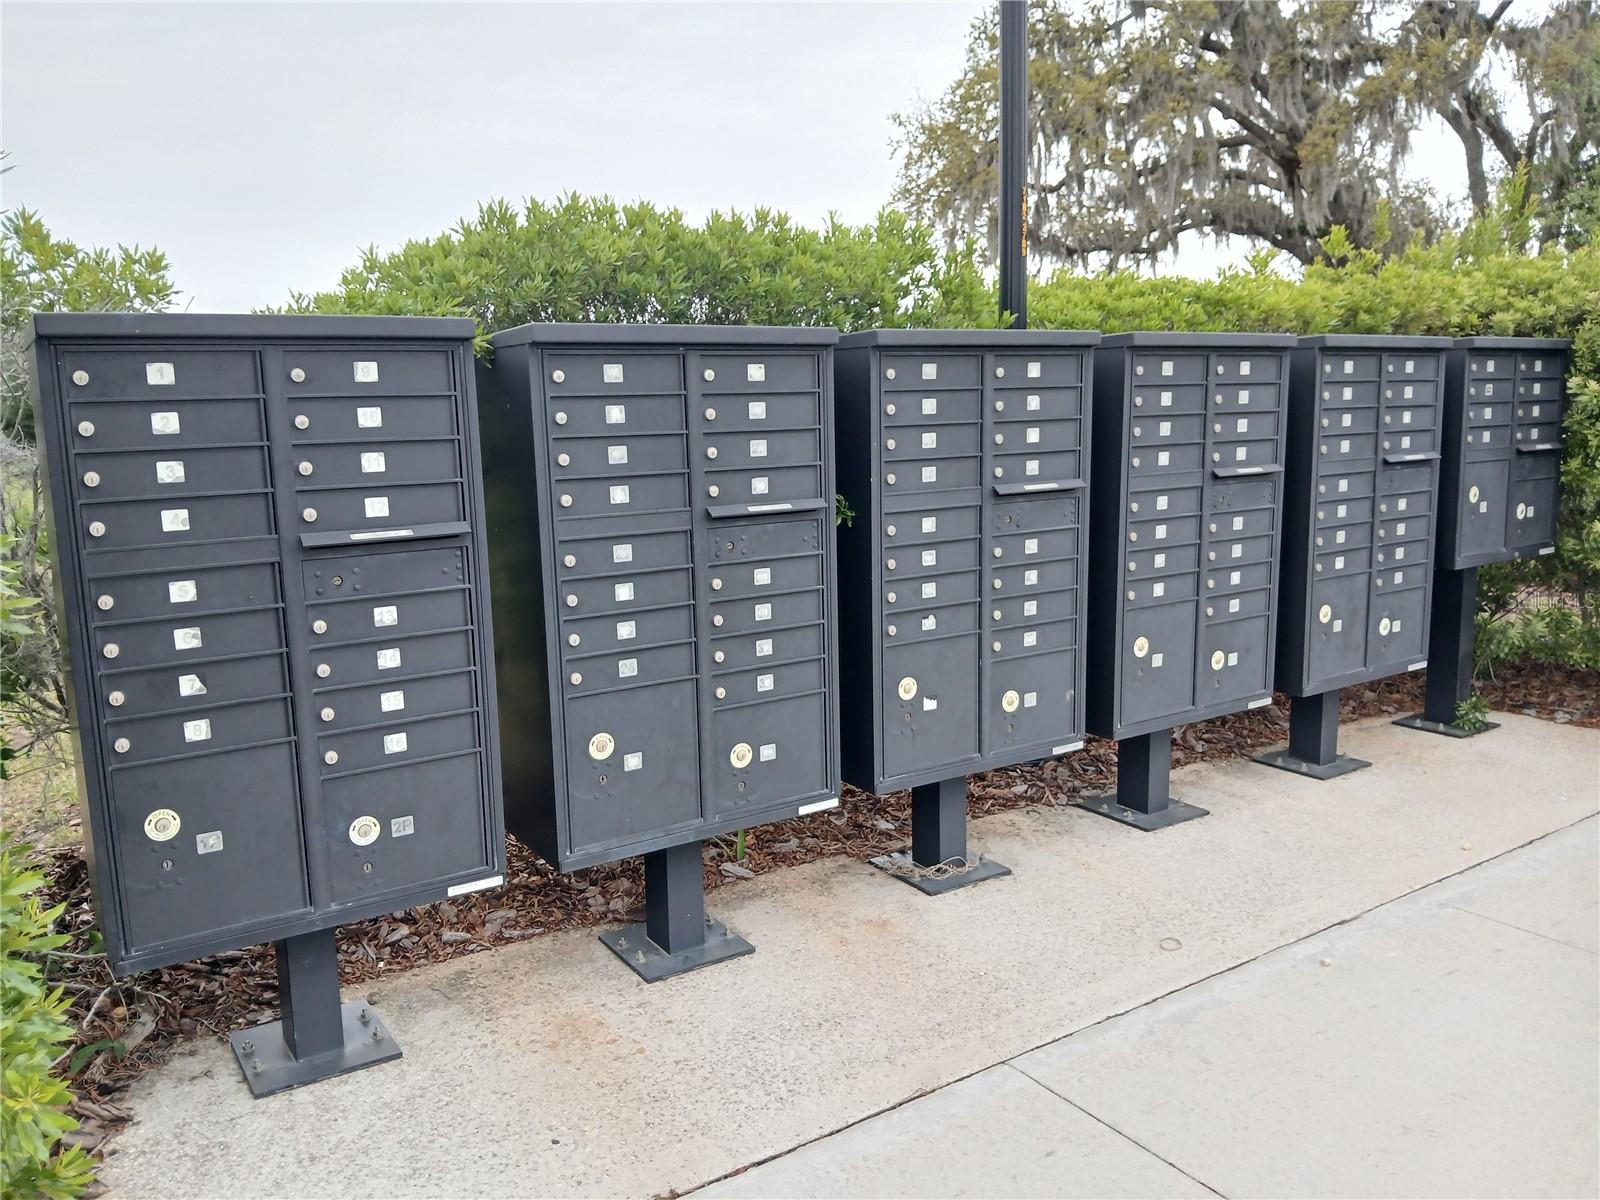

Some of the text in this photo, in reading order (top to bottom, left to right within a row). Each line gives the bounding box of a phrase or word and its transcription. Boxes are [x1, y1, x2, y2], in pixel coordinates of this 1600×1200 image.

[155, 366, 164, 380] 1
[361, 365, 370, 378] 9
[160, 416, 171, 430] 2
[360, 411, 378, 424] 10
[366, 456, 381, 469] 11
[166, 465, 176, 479] 3
[369, 500, 385, 513] 12
[170, 513, 180, 527] 4
[178, 584, 188, 598] 5
[376, 610, 394, 623] 13
[182, 631, 193, 645] 6
[382, 651, 398, 665] 14
[187, 679, 197, 692] 7
[192, 723, 202, 737] 8
[152, 811, 171, 819] OPEN
[356, 817, 373, 826] OPEN
[393, 818, 412, 833] 2P
